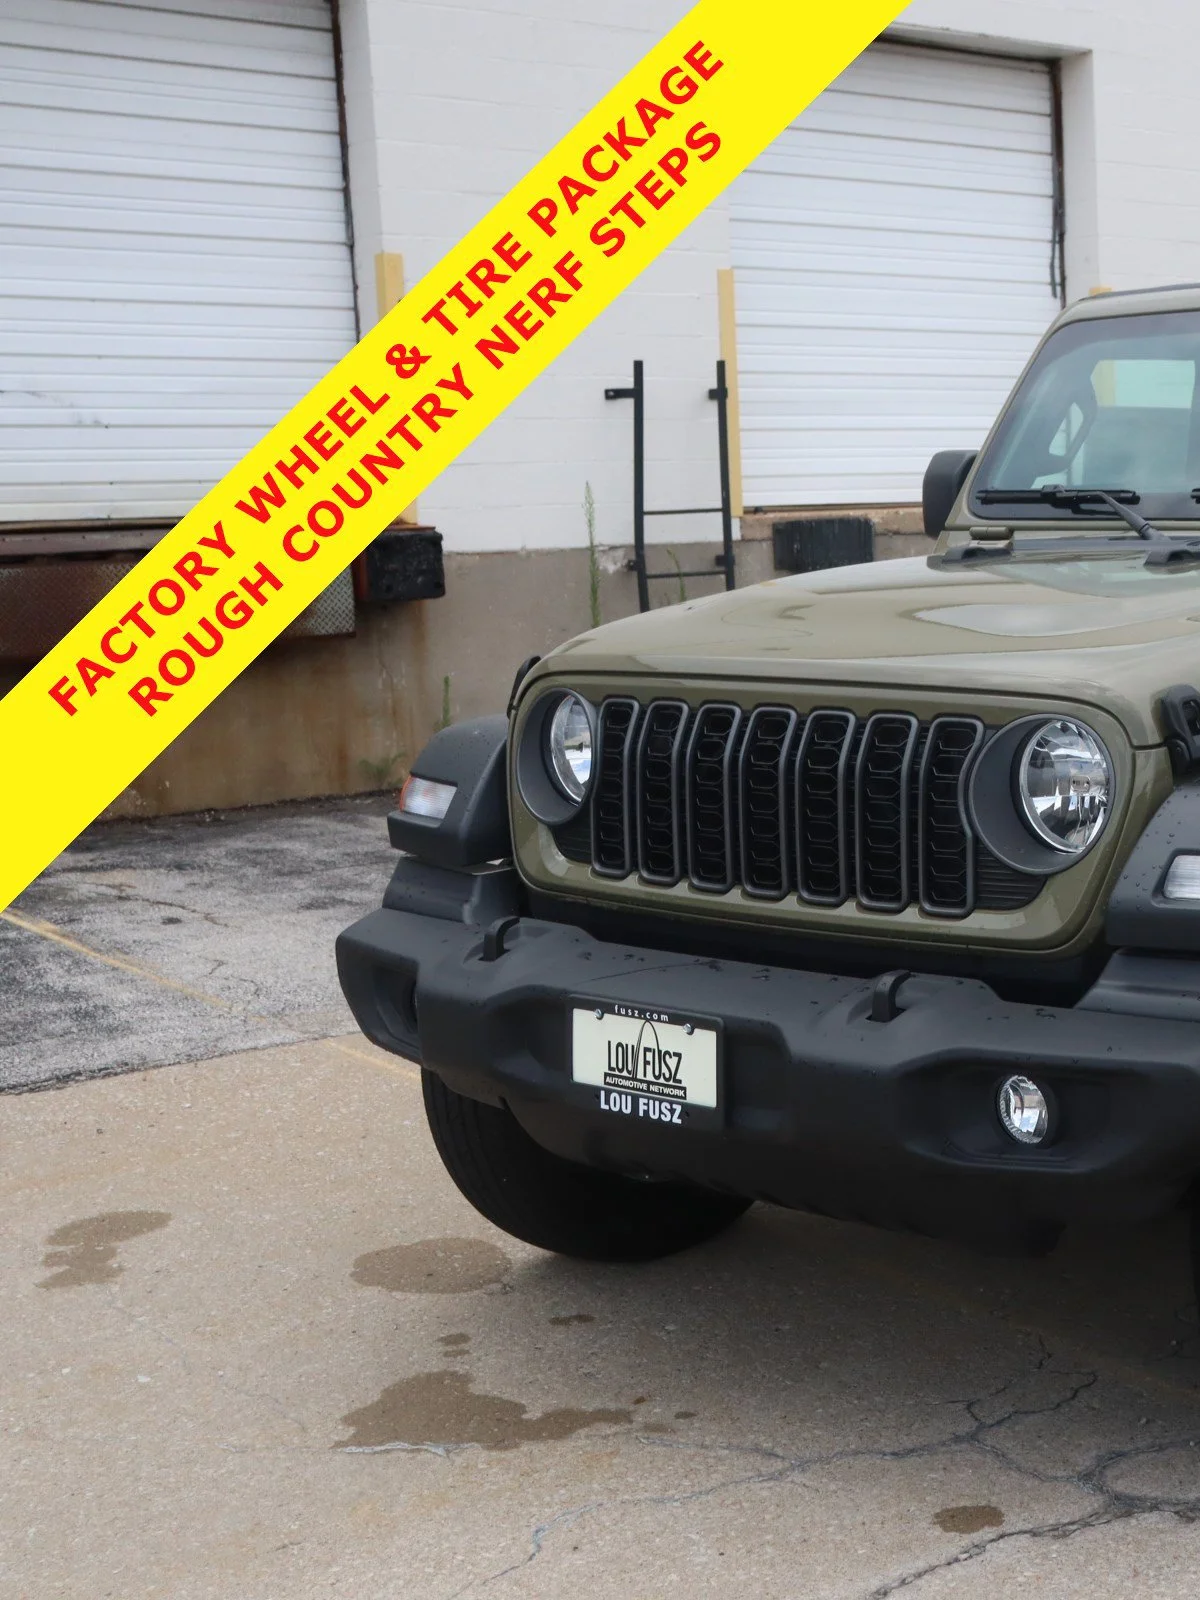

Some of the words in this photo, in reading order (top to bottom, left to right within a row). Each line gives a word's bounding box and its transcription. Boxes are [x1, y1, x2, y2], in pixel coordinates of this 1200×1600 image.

[614, 1004, 669, 1022] fusz.com
[607, 1040, 635, 1076] LOU
[643, 1046, 683, 1084] FUSZ
[605, 1076, 648, 1091] AUTOMOTIVE
[649, 1084, 685, 1097] NETWORK
[600, 1090, 632, 1114] LOU
[638, 1097, 682, 1125] FUSZ
